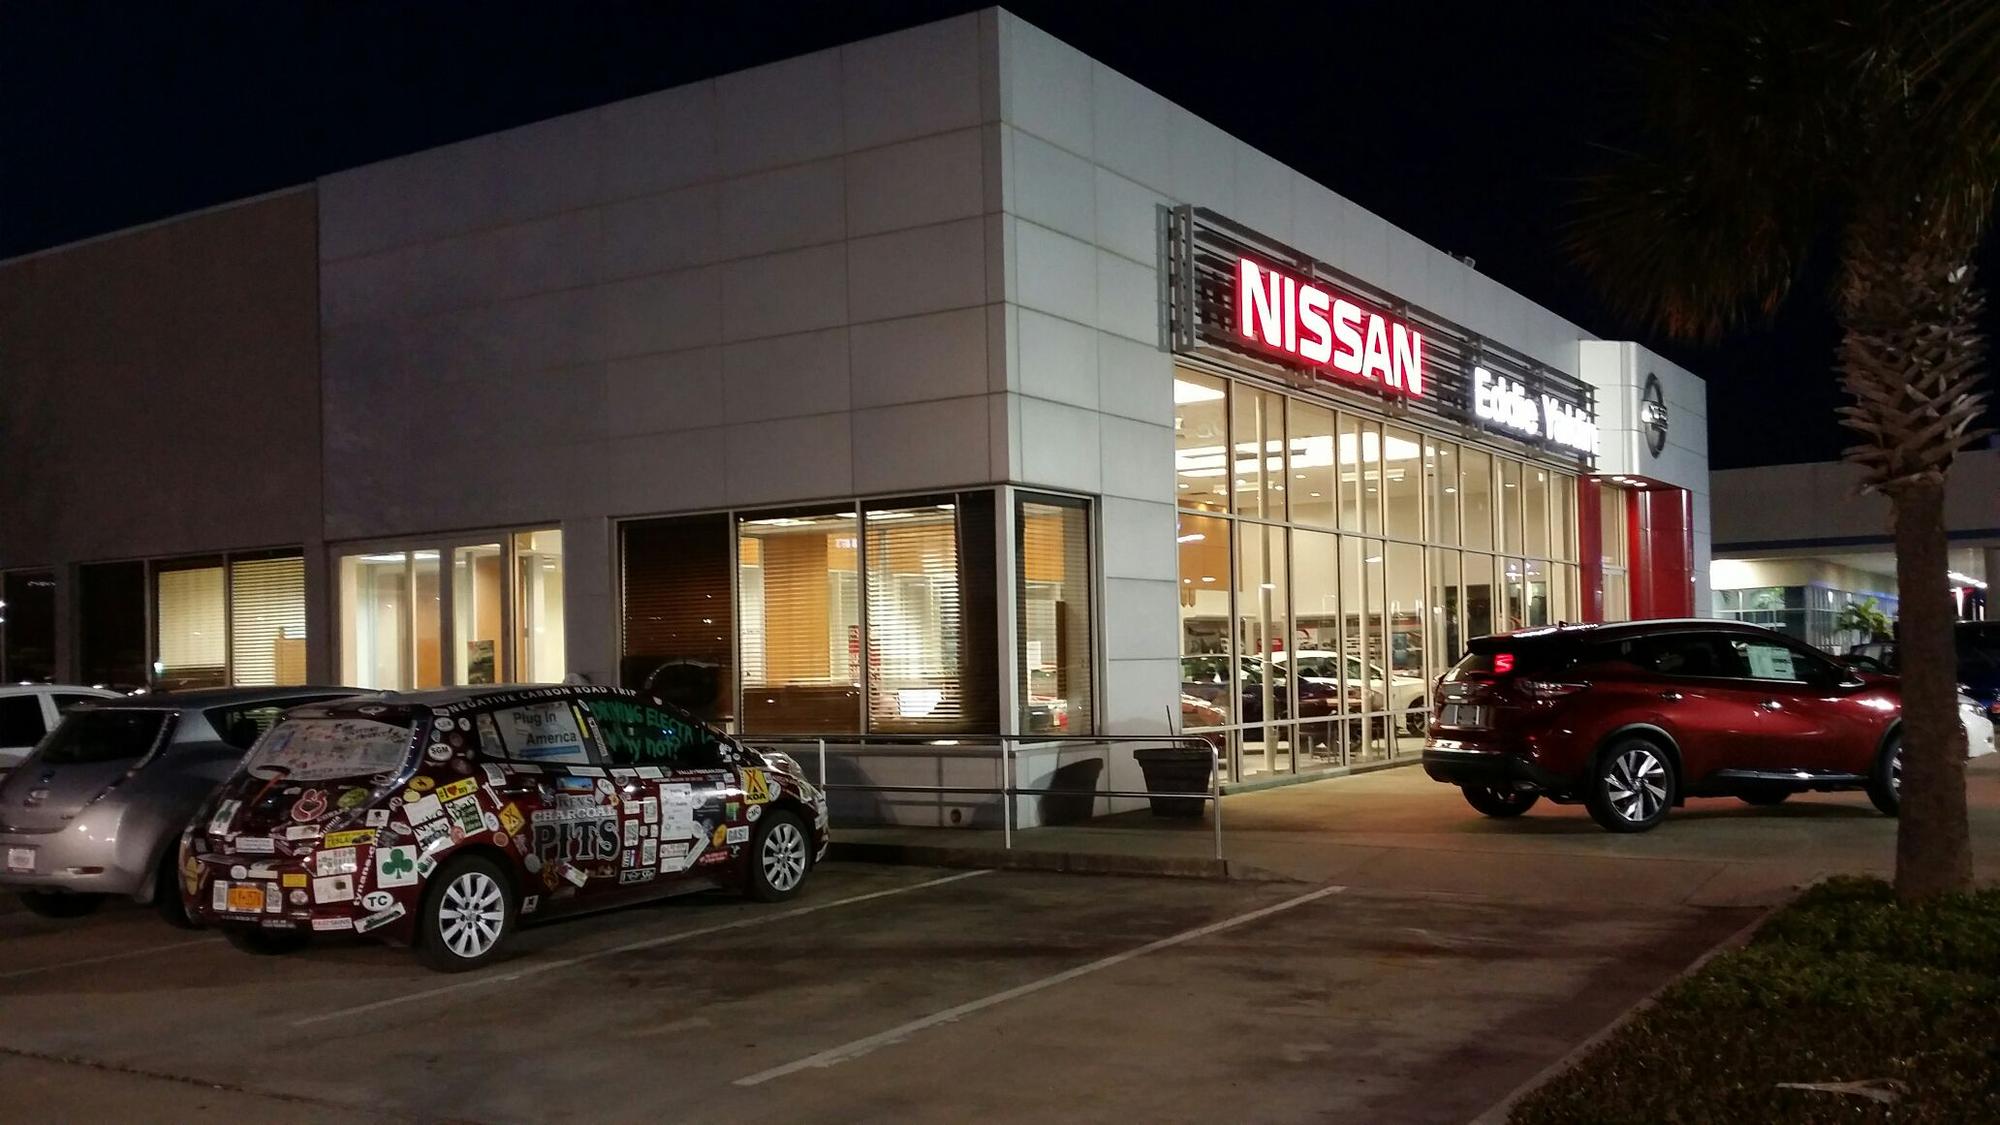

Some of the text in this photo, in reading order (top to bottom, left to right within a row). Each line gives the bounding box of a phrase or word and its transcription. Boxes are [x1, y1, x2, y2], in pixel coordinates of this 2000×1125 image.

[1239, 257, 1422, 396] NISSAN
[1475, 366, 1539, 435] Eddie
[447, 686, 637, 713] NEGATIVE CARBON ROAD TRIP
[512, 711, 557, 727] Plug In
[526, 731, 578, 746] America
[746, 792, 766, 801] KOA
[532, 819, 620, 863] PITS
[367, 895, 388, 908] TC
